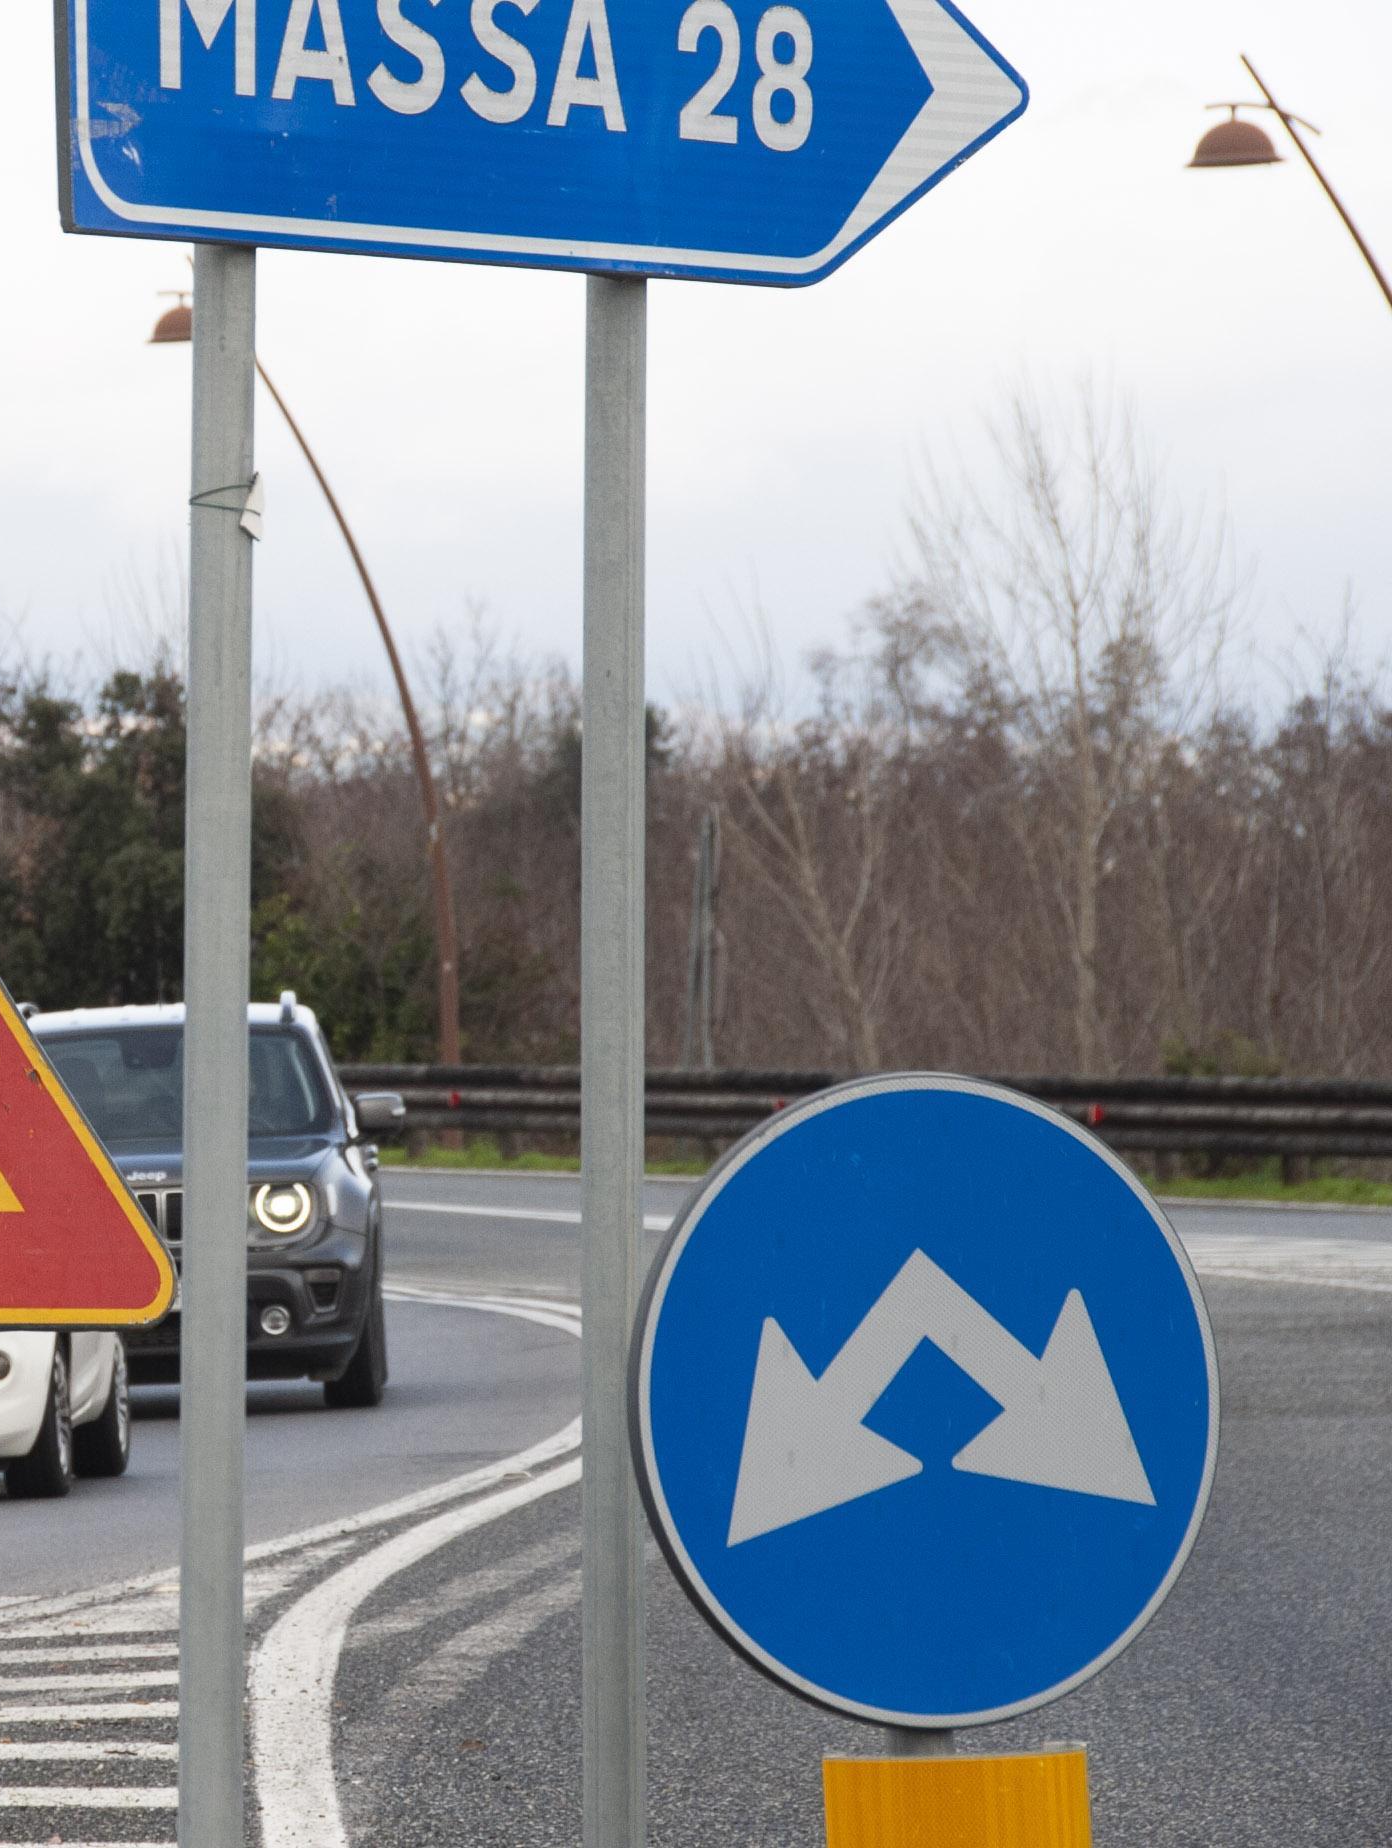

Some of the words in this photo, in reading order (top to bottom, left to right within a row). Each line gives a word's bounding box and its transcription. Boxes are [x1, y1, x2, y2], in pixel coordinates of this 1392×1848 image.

[159, 0, 627, 132] MASSA
[677, 0, 814, 152] 28
[126, 1171, 167, 1182] Jeep
